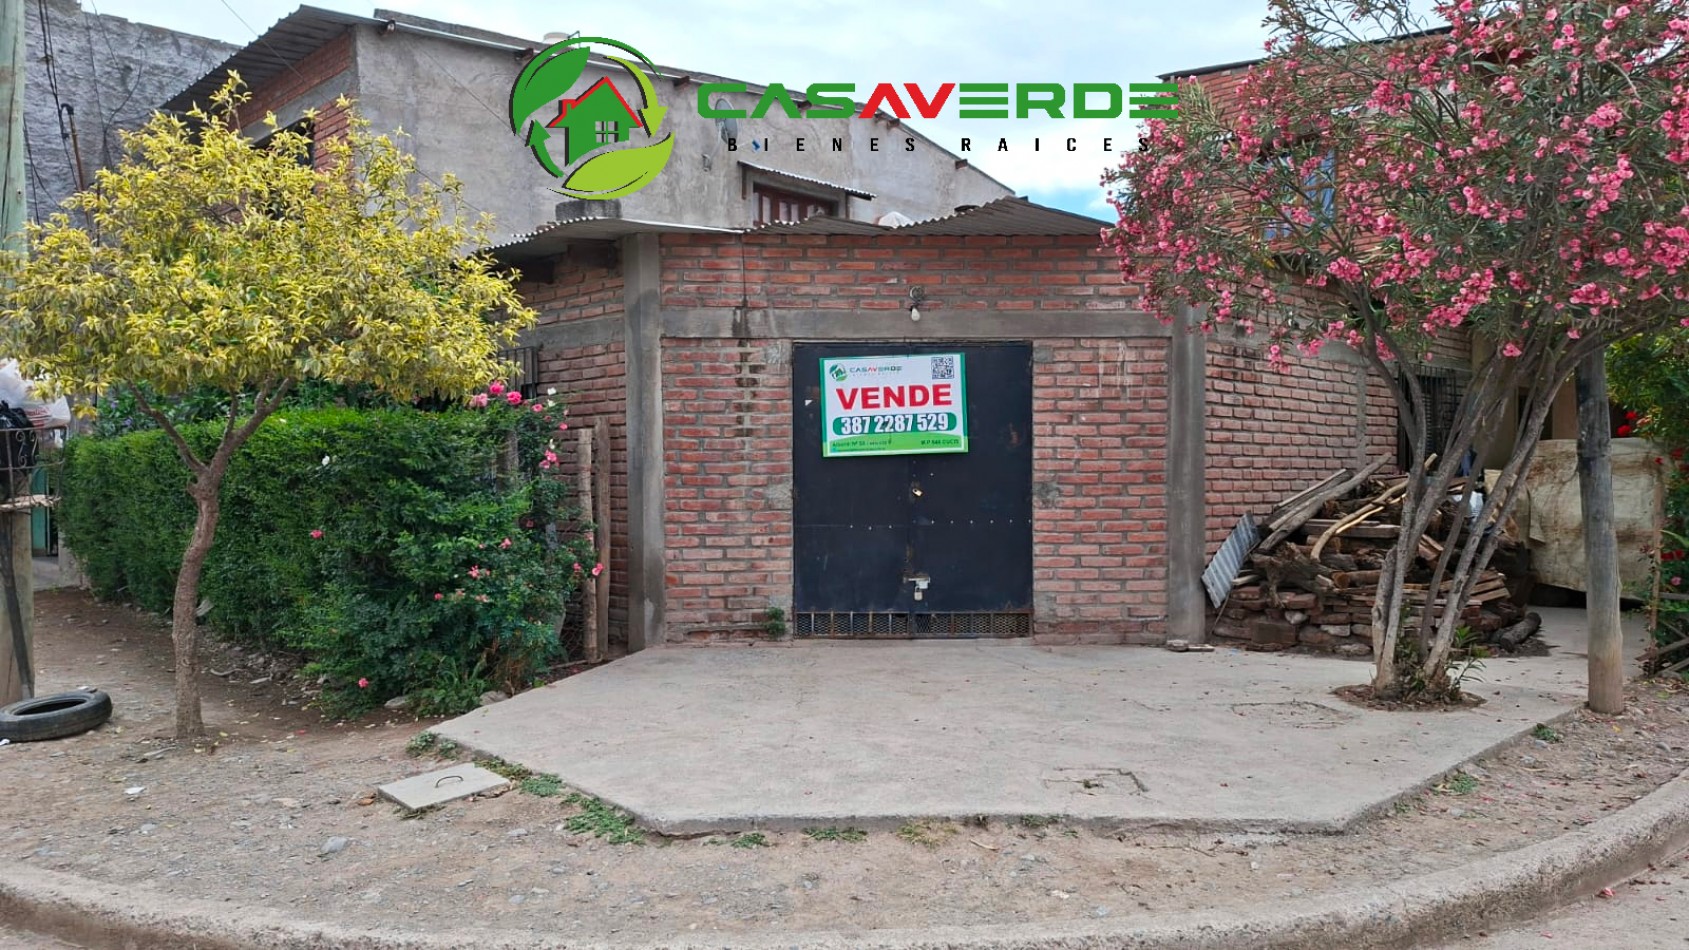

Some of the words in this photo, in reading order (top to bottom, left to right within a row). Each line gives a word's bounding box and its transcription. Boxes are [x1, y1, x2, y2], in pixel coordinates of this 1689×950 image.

[849, 365, 903, 373] CASAVERDE
[836, 384, 952, 410] VENDE
[841, 416, 870, 435] 387
[874, 414, 913, 433] 2287
[917, 412, 949, 431] 529
